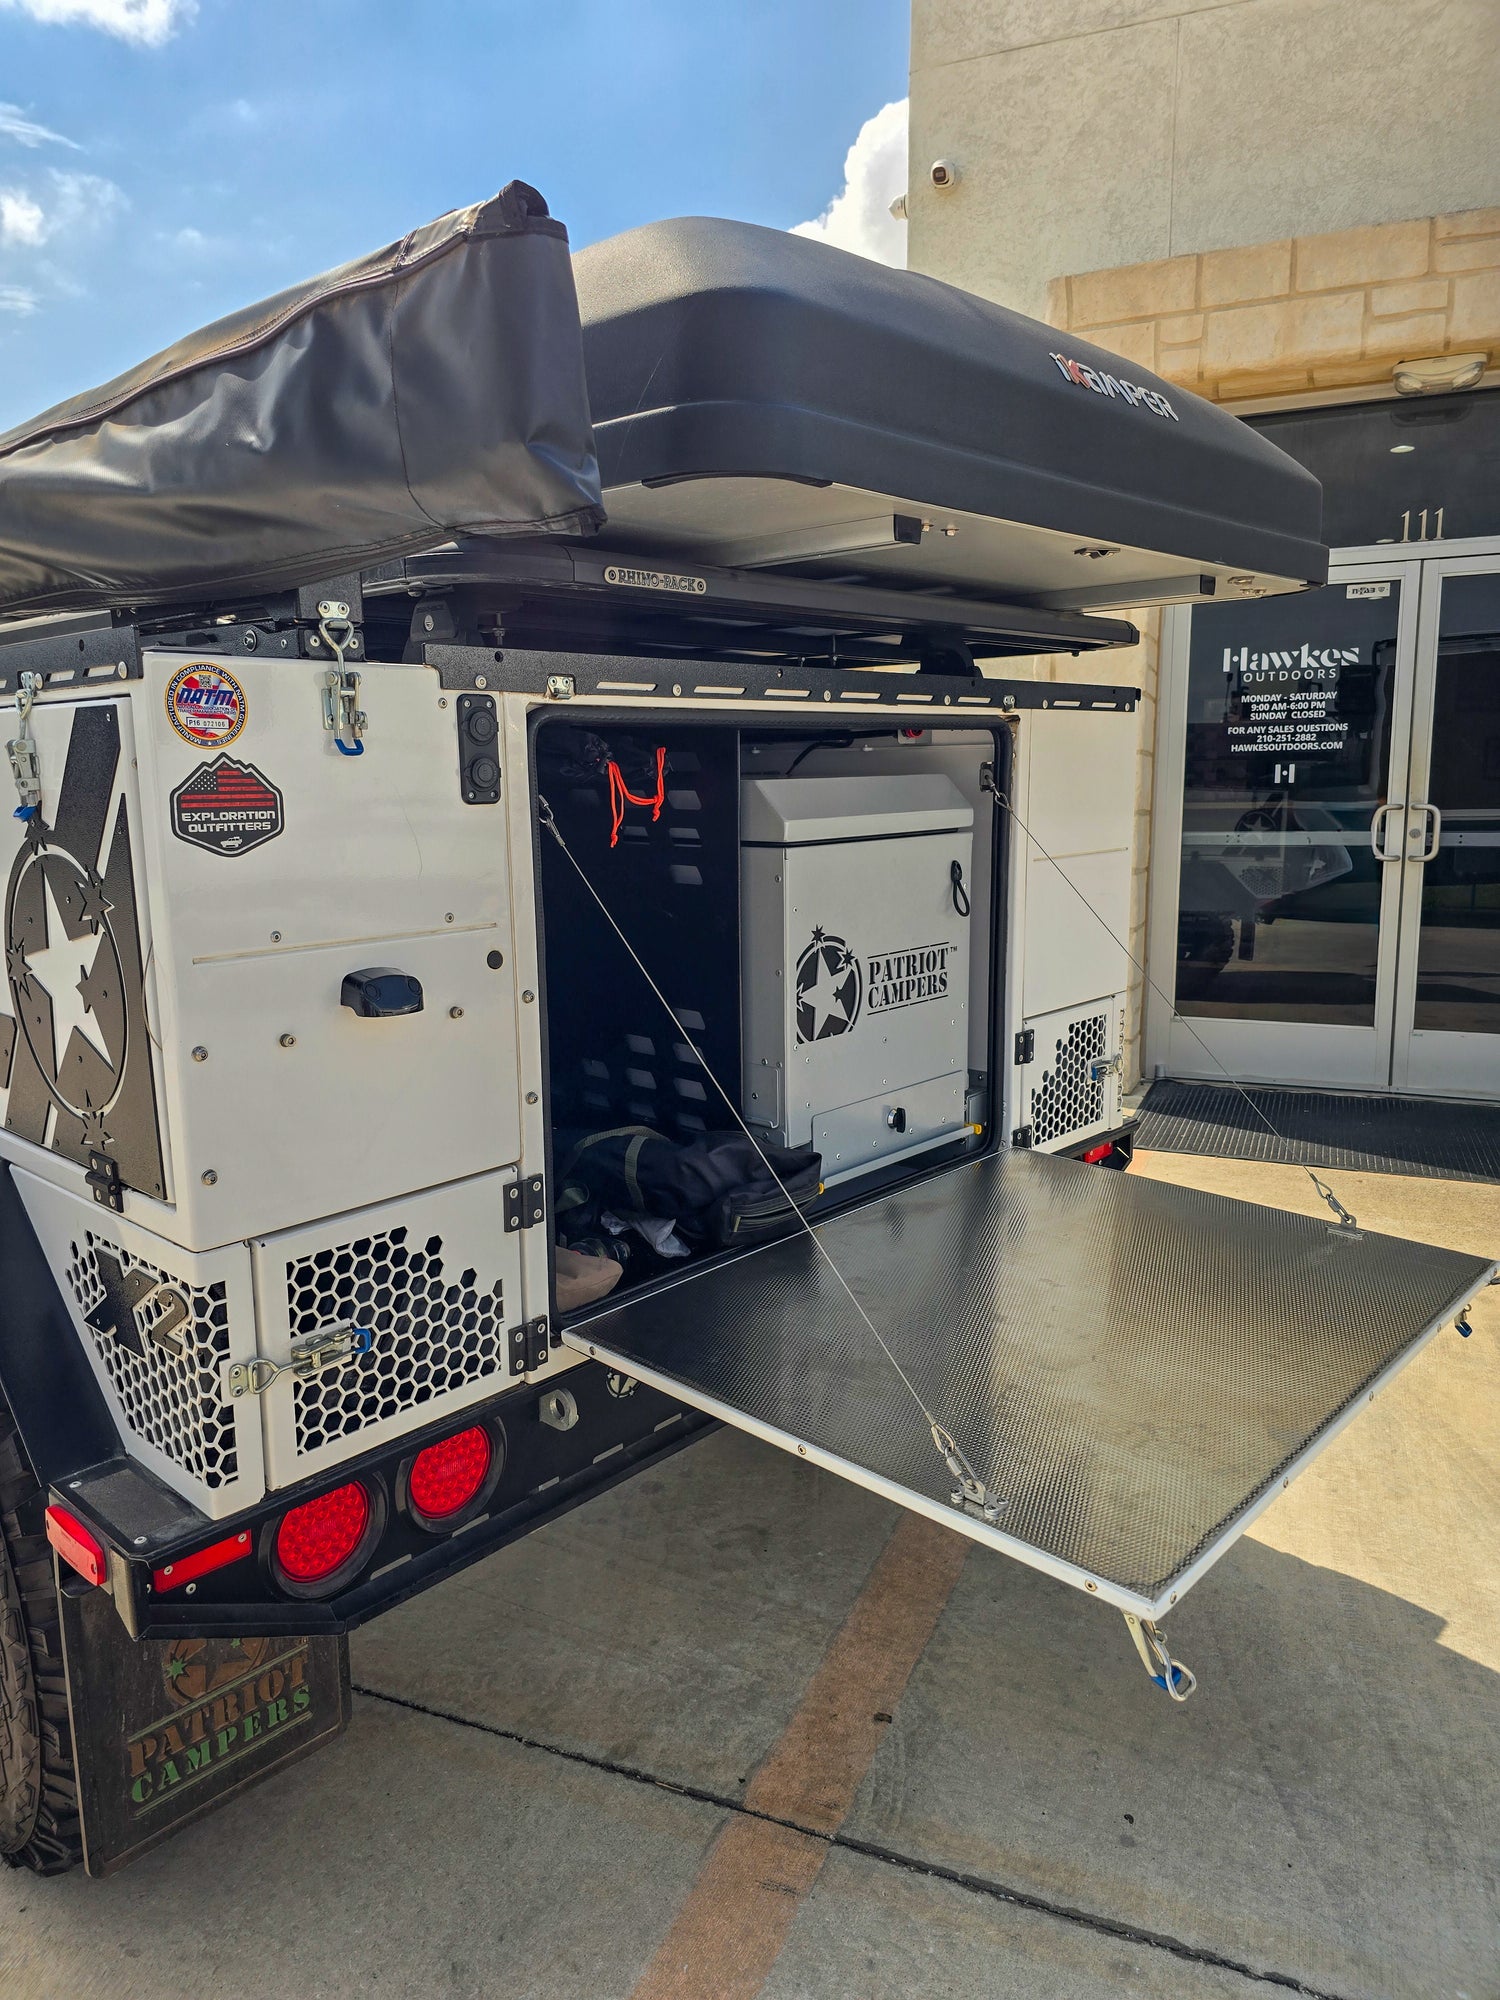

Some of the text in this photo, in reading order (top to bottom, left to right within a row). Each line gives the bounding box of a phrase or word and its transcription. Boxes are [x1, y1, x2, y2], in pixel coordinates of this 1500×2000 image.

[1399, 507, 1445, 543] 111
[618, 569, 697, 592] RHINO-RACK
[1223, 643, 1360, 672] Hawkes
[177, 664, 222, 682] COMPLIANCE
[221, 671, 238, 689] WITH
[1243, 668, 1337, 682] OUTDOORS
[1241, 693, 1282, 703] MONDAY
[1289, 691, 1338, 701] SATURDAY
[1250, 703, 1270, 712] 9:00
[1310, 701, 1326, 710] PM
[167, 691, 202, 745] MANUFACTURED
[188, 719, 201, 727] P16
[1250, 710, 1326, 720] SUNDAY CLOSED
[1227, 726, 1246, 735] FOR
[1246, 725, 1267, 734] ANY
[1267, 724, 1295, 734] SALES
[1256, 733, 1317, 743] 210-251-2882
[1230, 741, 1343, 752] HAWKESOUTDOORS.COM
[182, 810, 276, 822] EXPLORATION
[188, 821, 271, 833] OUTFITTERS
[868, 971, 948, 1009] CAMPERS
[84, 1247, 189, 1359] X2
[128, 1652, 309, 1777] PATRIOT
[131, 1684, 311, 1803] CAMPERS
